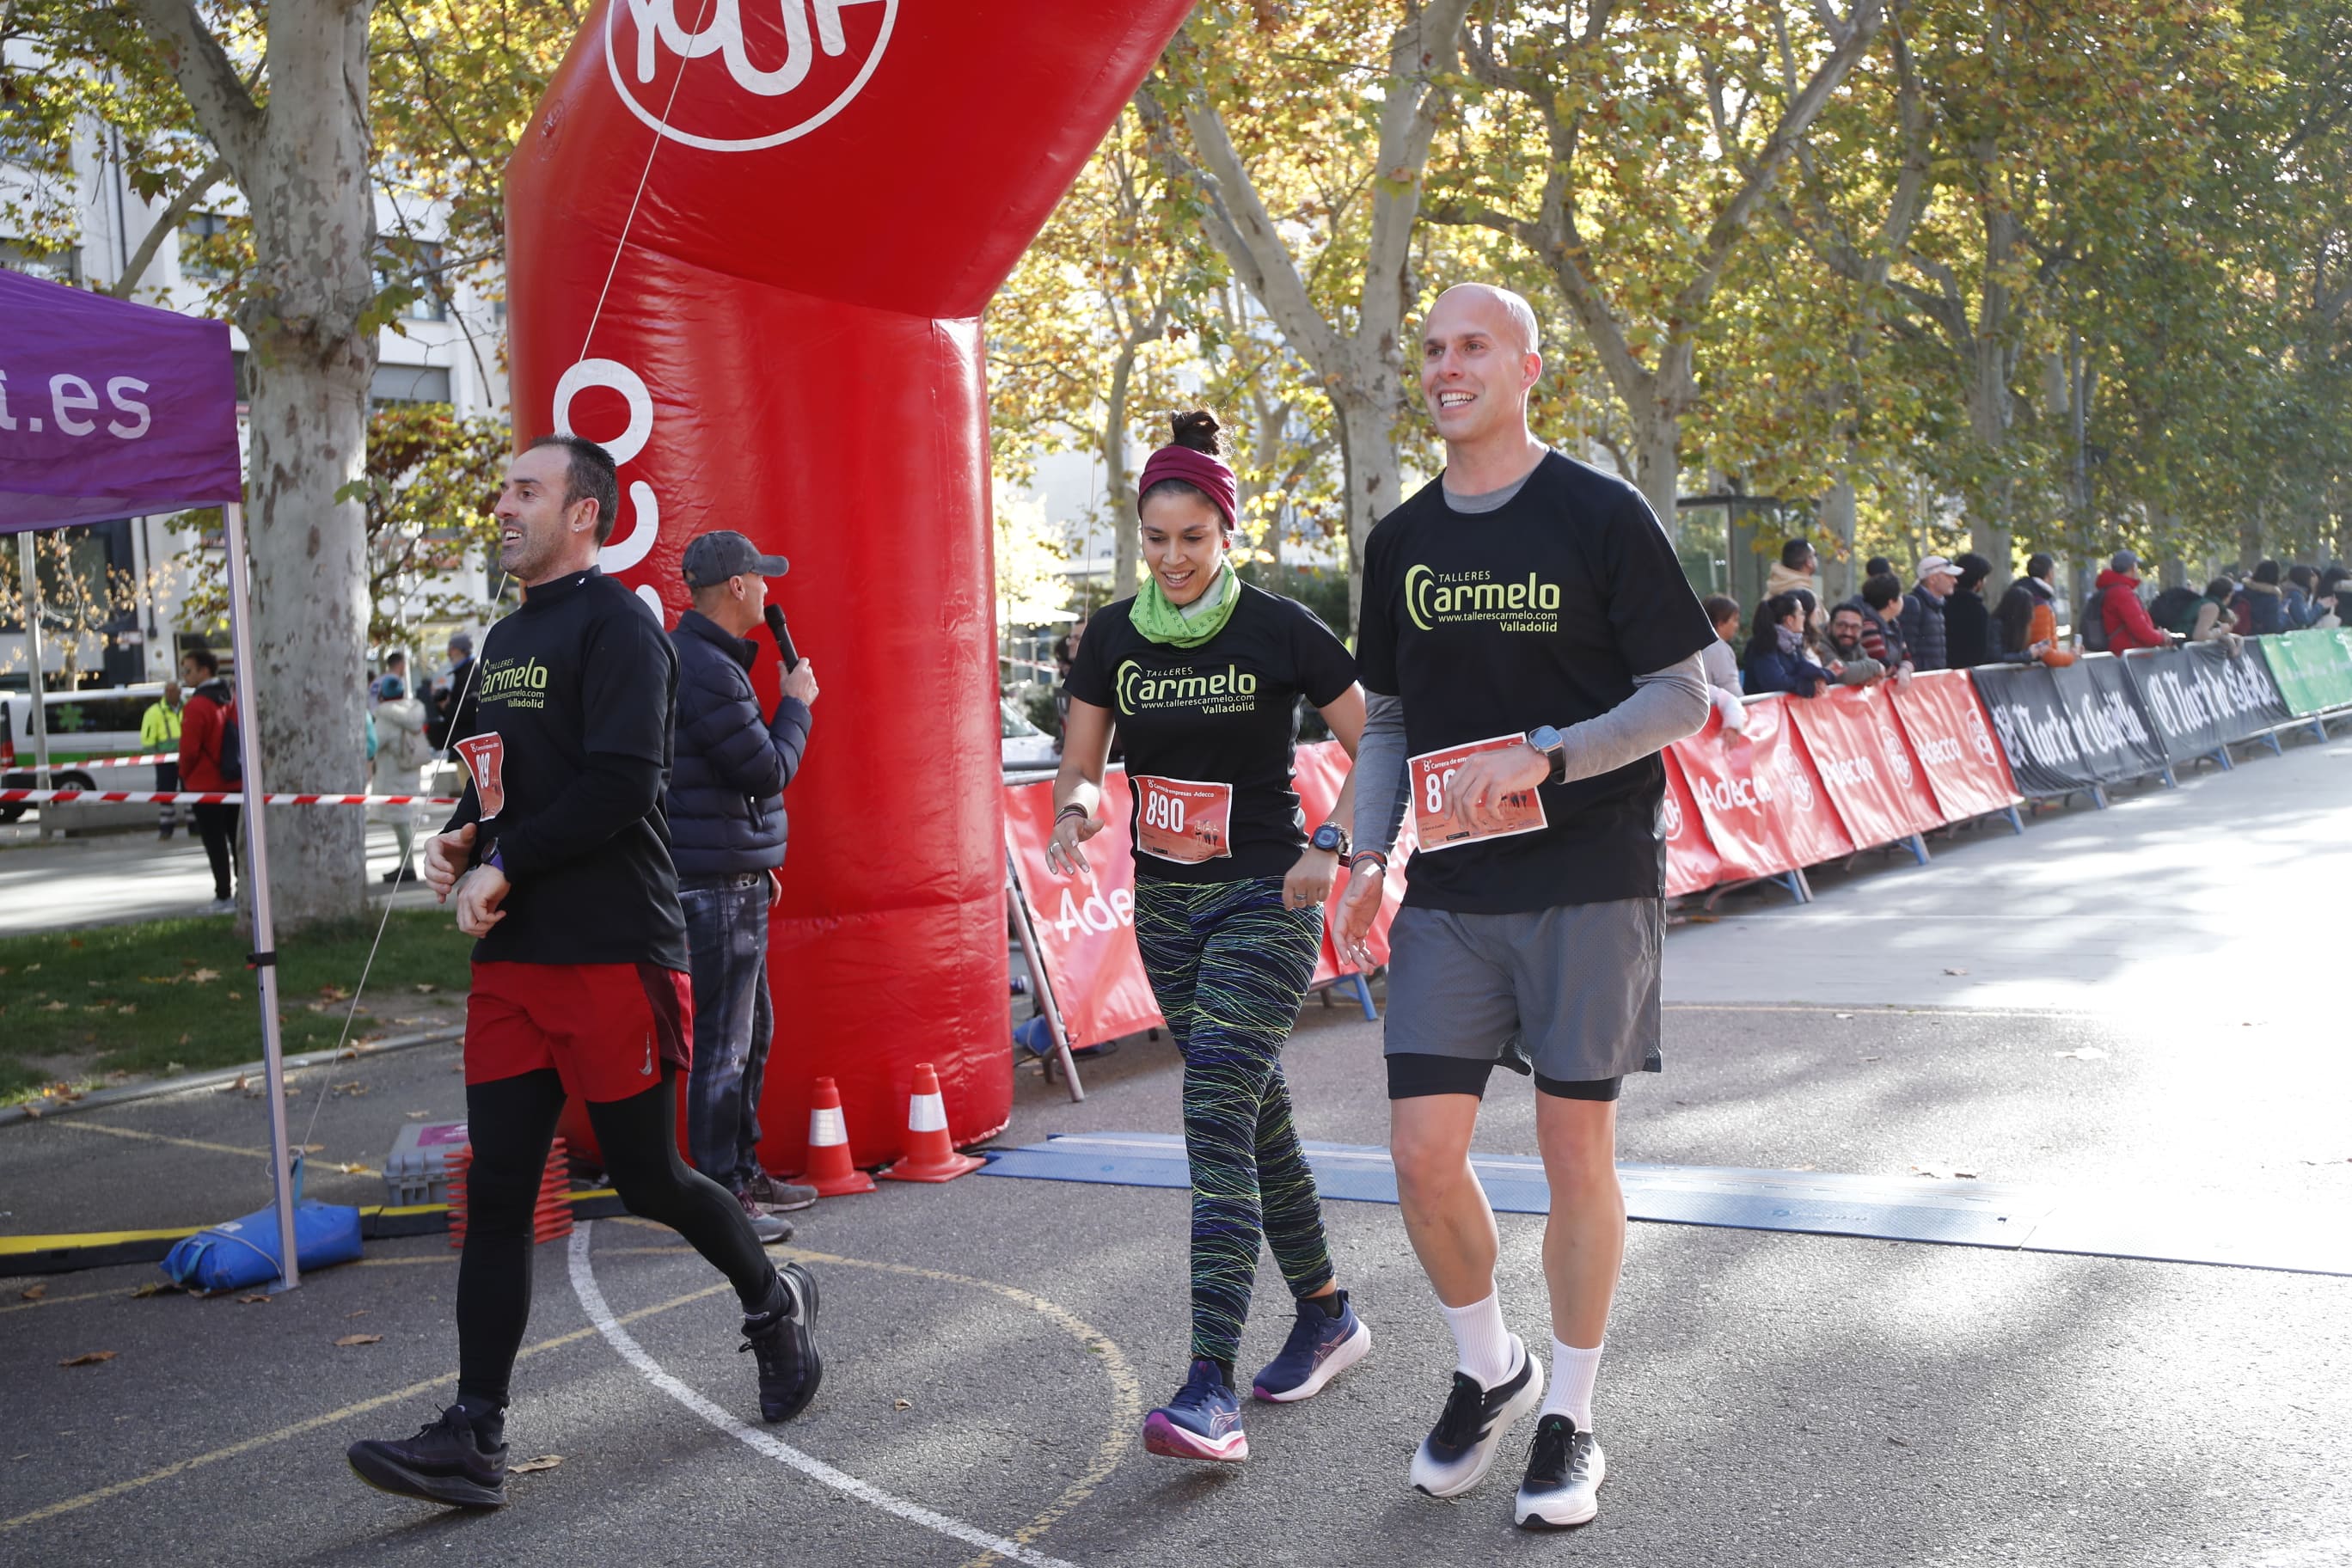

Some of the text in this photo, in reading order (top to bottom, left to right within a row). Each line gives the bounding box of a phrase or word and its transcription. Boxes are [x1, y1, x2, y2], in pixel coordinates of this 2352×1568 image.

[1438, 571, 1491, 583] TALLERES
[1438, 610, 1558, 622] www.tallerescarmelo.com
[1500, 621, 1558, 632] Valladolid
[490, 658, 514, 671] TALLERES
[1146, 667, 1193, 677] TALLERES
[508, 699, 544, 708] Valladolid
[1141, 695, 1255, 709] www.tallerescarmelo.com
[1203, 701, 1255, 714] Valladolid
[1146, 790, 1185, 833] 890
